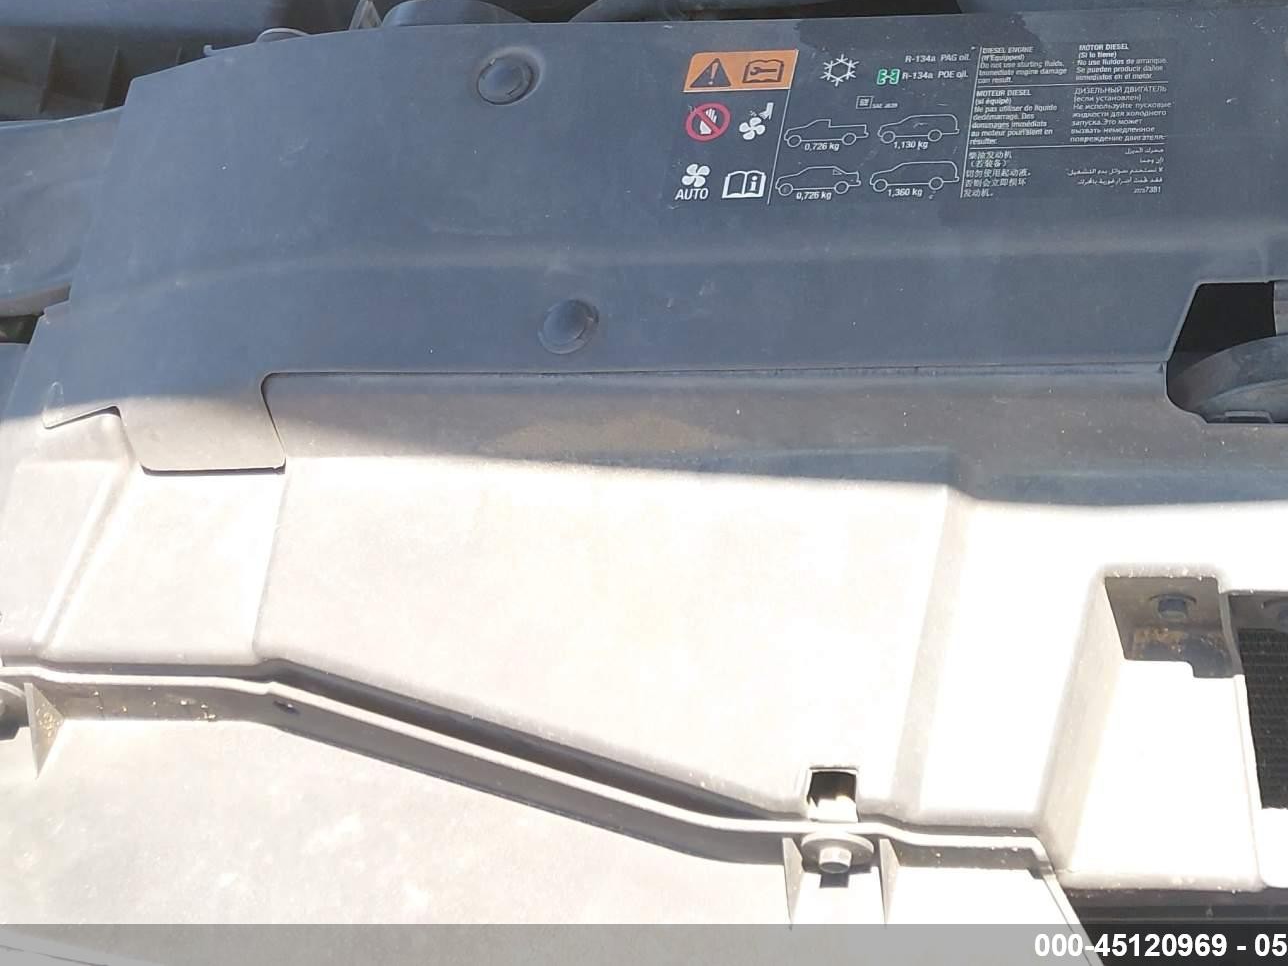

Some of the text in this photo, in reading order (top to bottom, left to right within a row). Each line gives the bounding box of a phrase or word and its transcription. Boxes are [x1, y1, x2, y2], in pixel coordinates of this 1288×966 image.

[1105, 43, 1129, 51] DIESEL
[905, 53, 971, 63] R-134a PAG oil.
[1040, 68, 1068, 76] damage
[1113, 65, 1141, 74] producir
[902, 71, 934, 80] R-134a
[938, 70, 955, 79] POE
[1075, 85, 1167, 95] ДИЗЕЛЬНЫЙ ДВИГАТЕЛЬ
[804, 142, 840, 152] 0,726 kg
[893, 140, 929, 150] 1,130 kg
[675, 187, 709, 200] AUTO
[796, 191, 832, 201] 0,726 kg
[912, 188, 923, 197] kg
